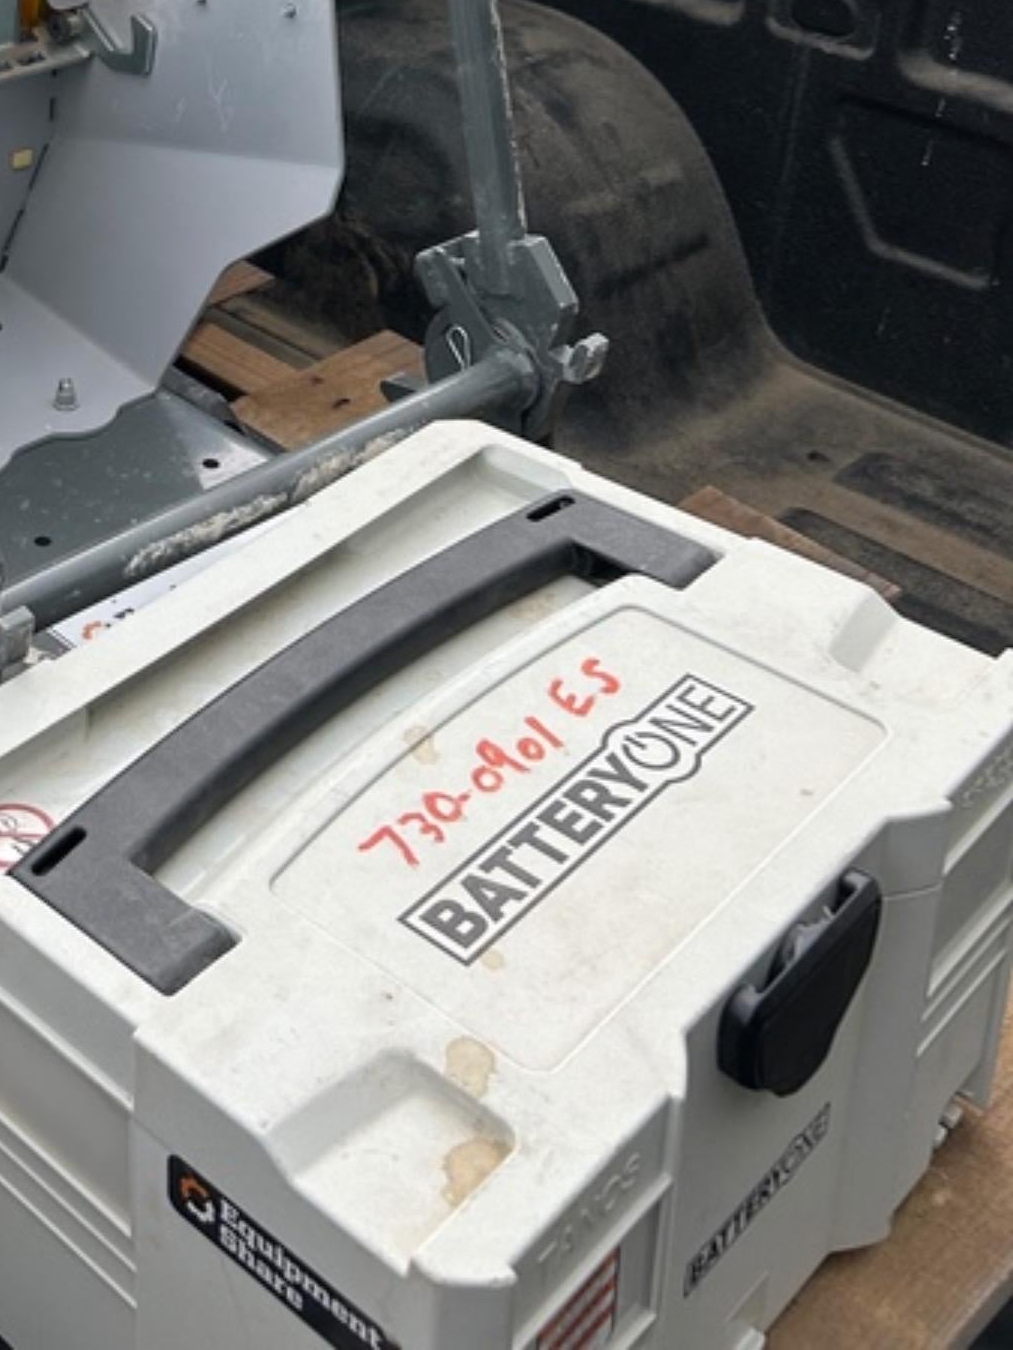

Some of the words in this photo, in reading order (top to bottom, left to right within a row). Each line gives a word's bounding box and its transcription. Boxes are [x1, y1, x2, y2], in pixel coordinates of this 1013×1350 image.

[418, 684, 738, 950] BATTERYONE
[219, 1222, 304, 1311] Share
[220, 1199, 383, 1350] Equipment
